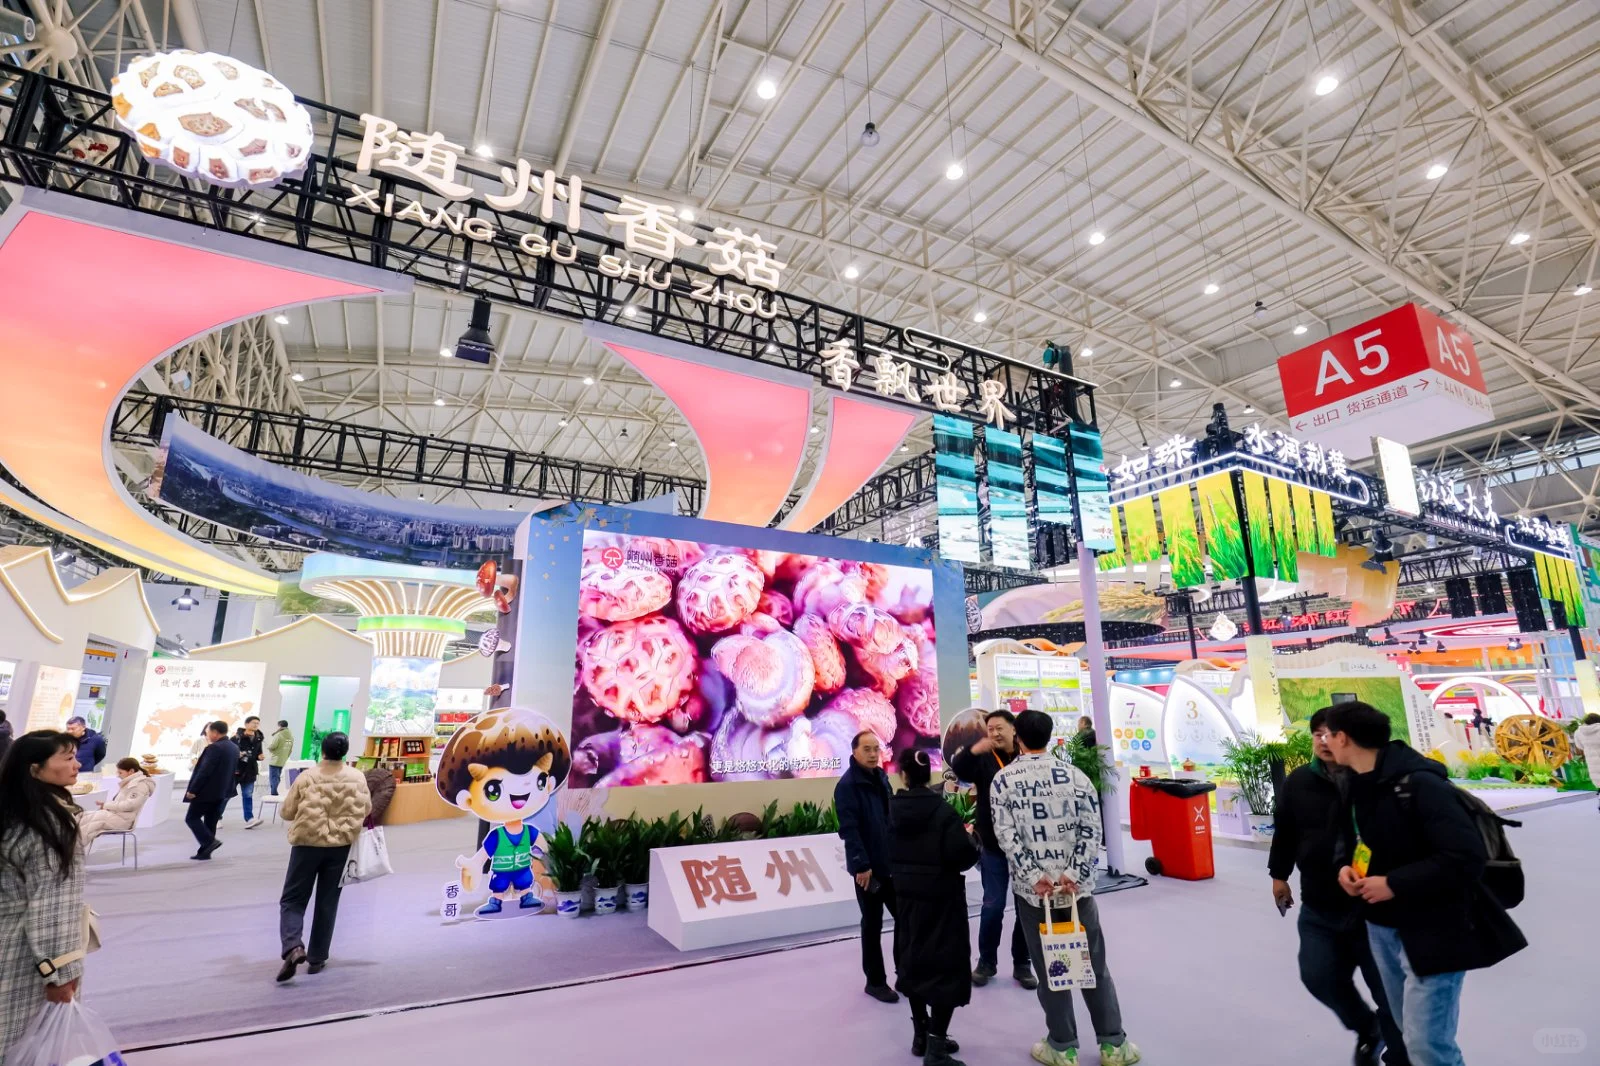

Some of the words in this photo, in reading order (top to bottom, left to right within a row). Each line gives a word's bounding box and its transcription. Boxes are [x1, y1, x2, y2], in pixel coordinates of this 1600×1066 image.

[357, 112, 787, 291] 随州香菇
[346, 184, 496, 240] XIANG
[519, 233, 578, 264] GU
[598, 254, 671, 290] SHU
[690, 280, 777, 319] ZHOU
[1315, 328, 1390, 397] A5
[1436, 325, 1470, 377] A5
[819, 339, 1017, 430] 香飘世界
[1313, 408, 1339, 427] 出口
[1347, 384, 1408, 415] 货运通道
[1105, 433, 1196, 484] 如珠
[1245, 422, 1351, 483] 水润荆楚
[445, 884, 459, 918] 香哥
[679, 847, 848, 908] 随州
